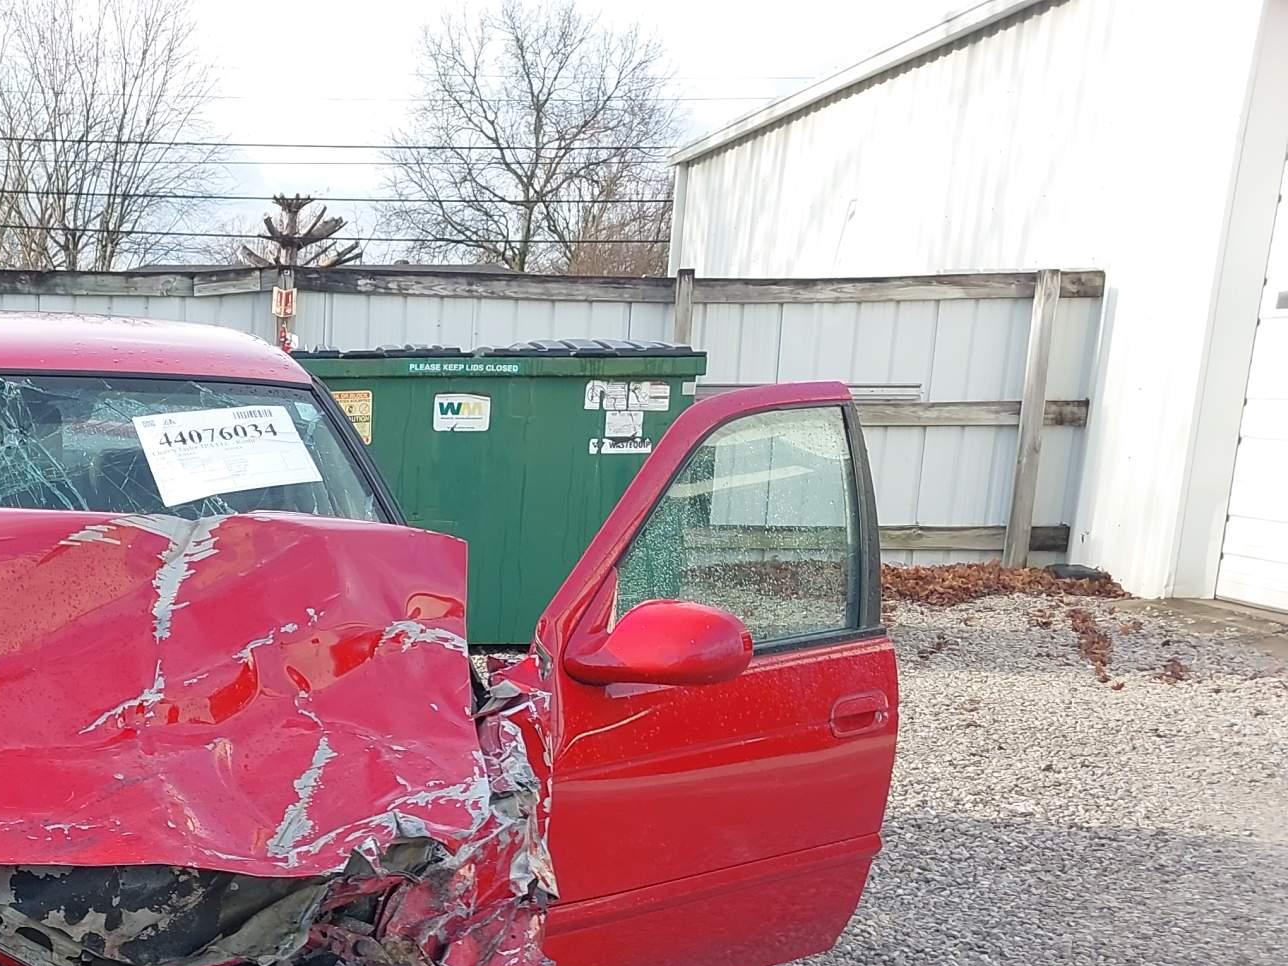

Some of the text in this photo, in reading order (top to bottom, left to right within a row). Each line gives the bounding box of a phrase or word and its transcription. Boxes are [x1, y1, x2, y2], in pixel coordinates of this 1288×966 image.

[409, 363, 519, 372] PLEASE KEEP LIDS CLOSED
[438, 402, 483, 416] WM
[159, 423, 278, 447] 44076034
